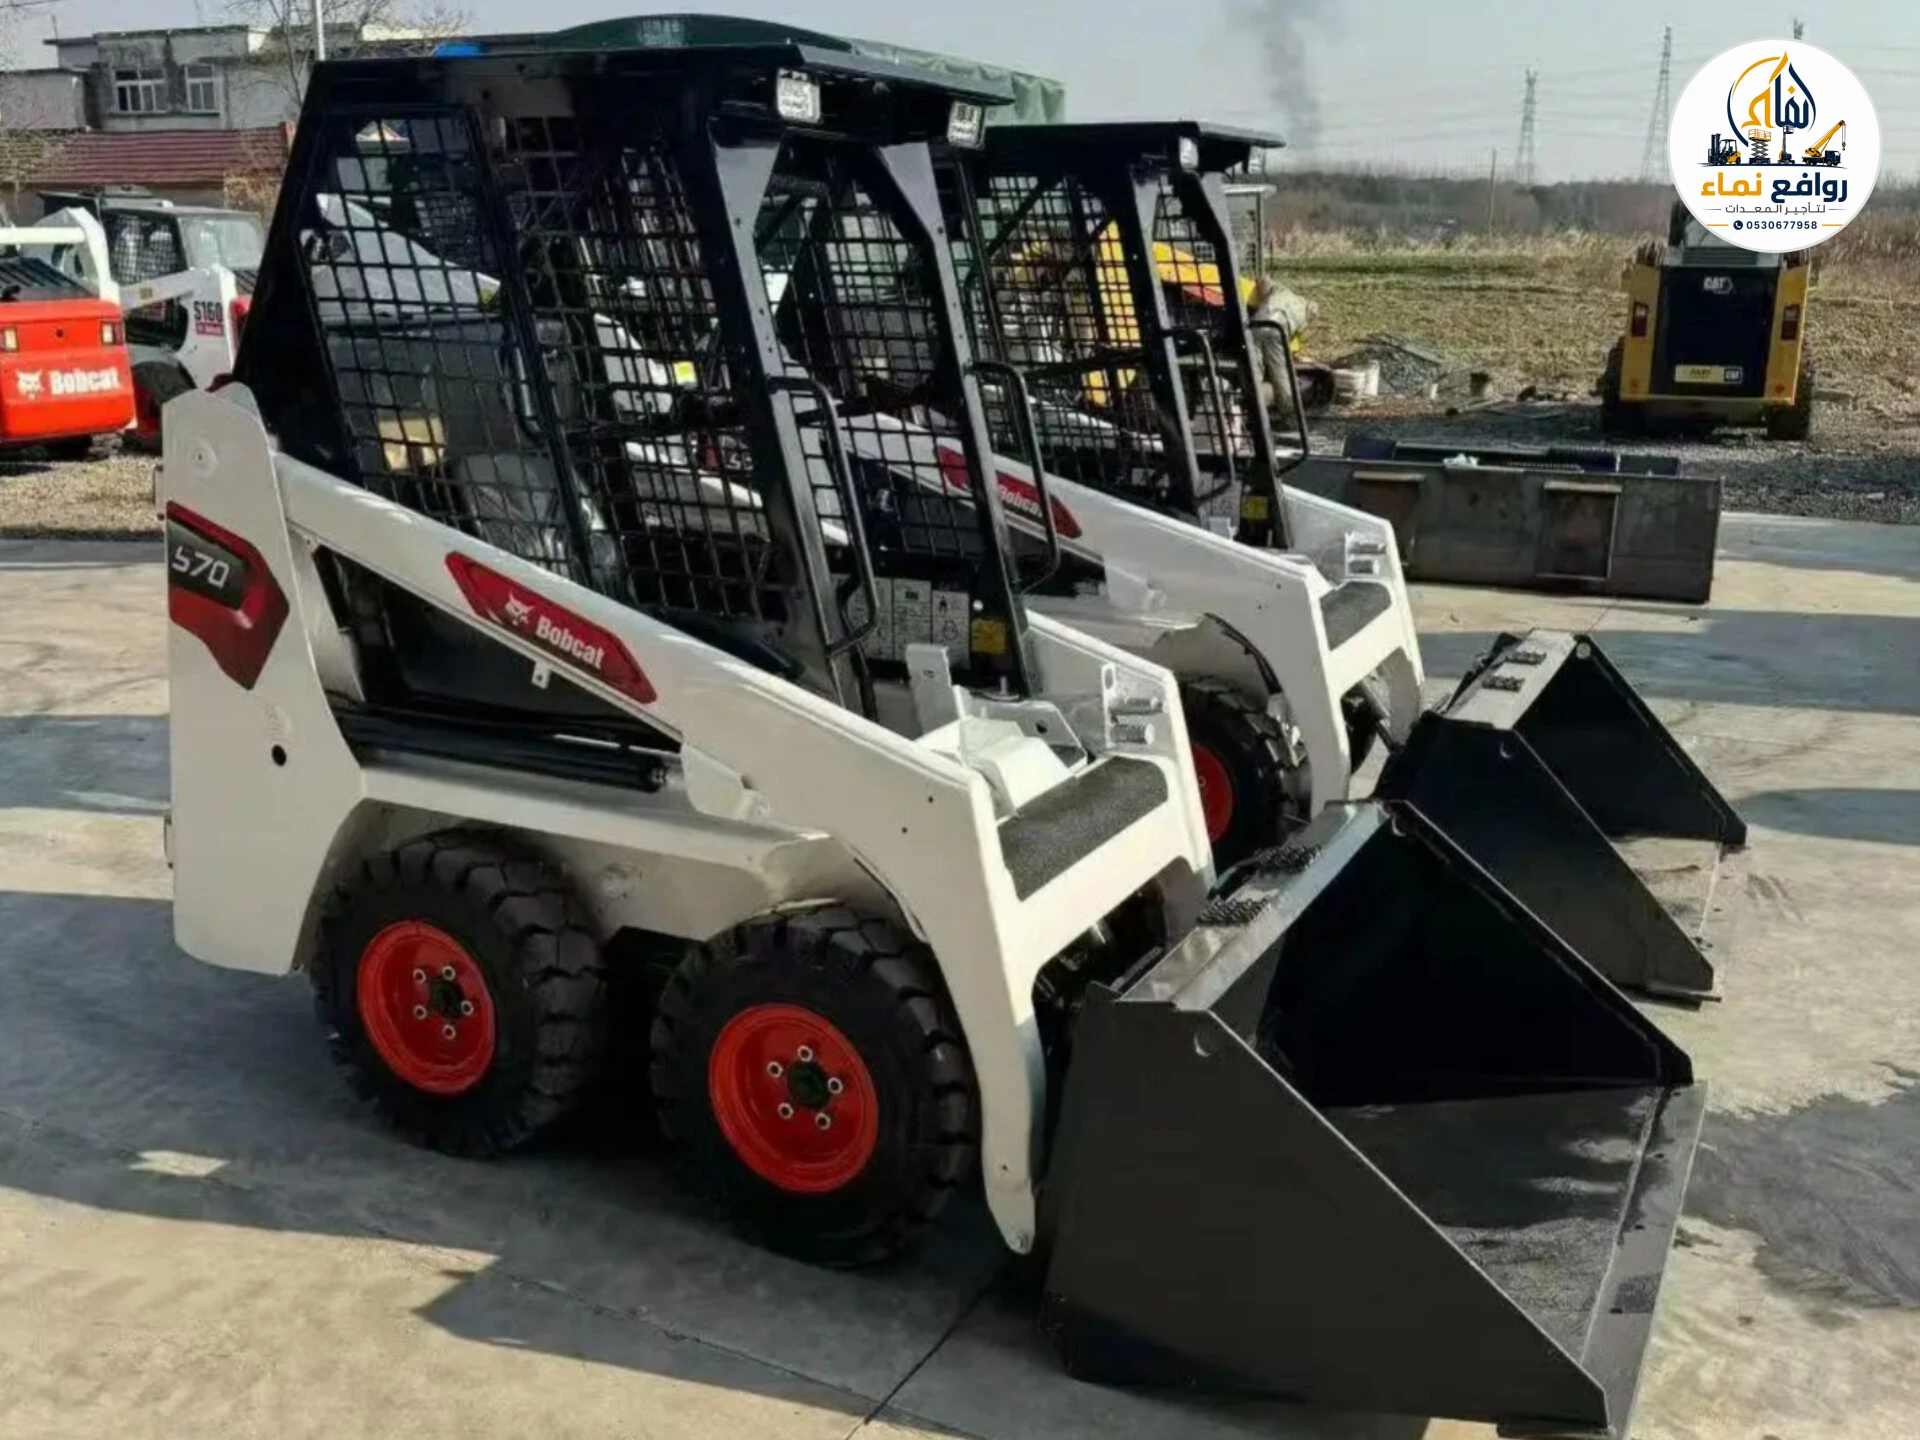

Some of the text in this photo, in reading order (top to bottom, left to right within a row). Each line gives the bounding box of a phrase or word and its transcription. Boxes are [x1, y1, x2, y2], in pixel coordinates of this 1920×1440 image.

[194, 300, 223, 322] S160
[49, 367, 120, 395] Bobcat
[535, 615, 606, 670] Bobcat
